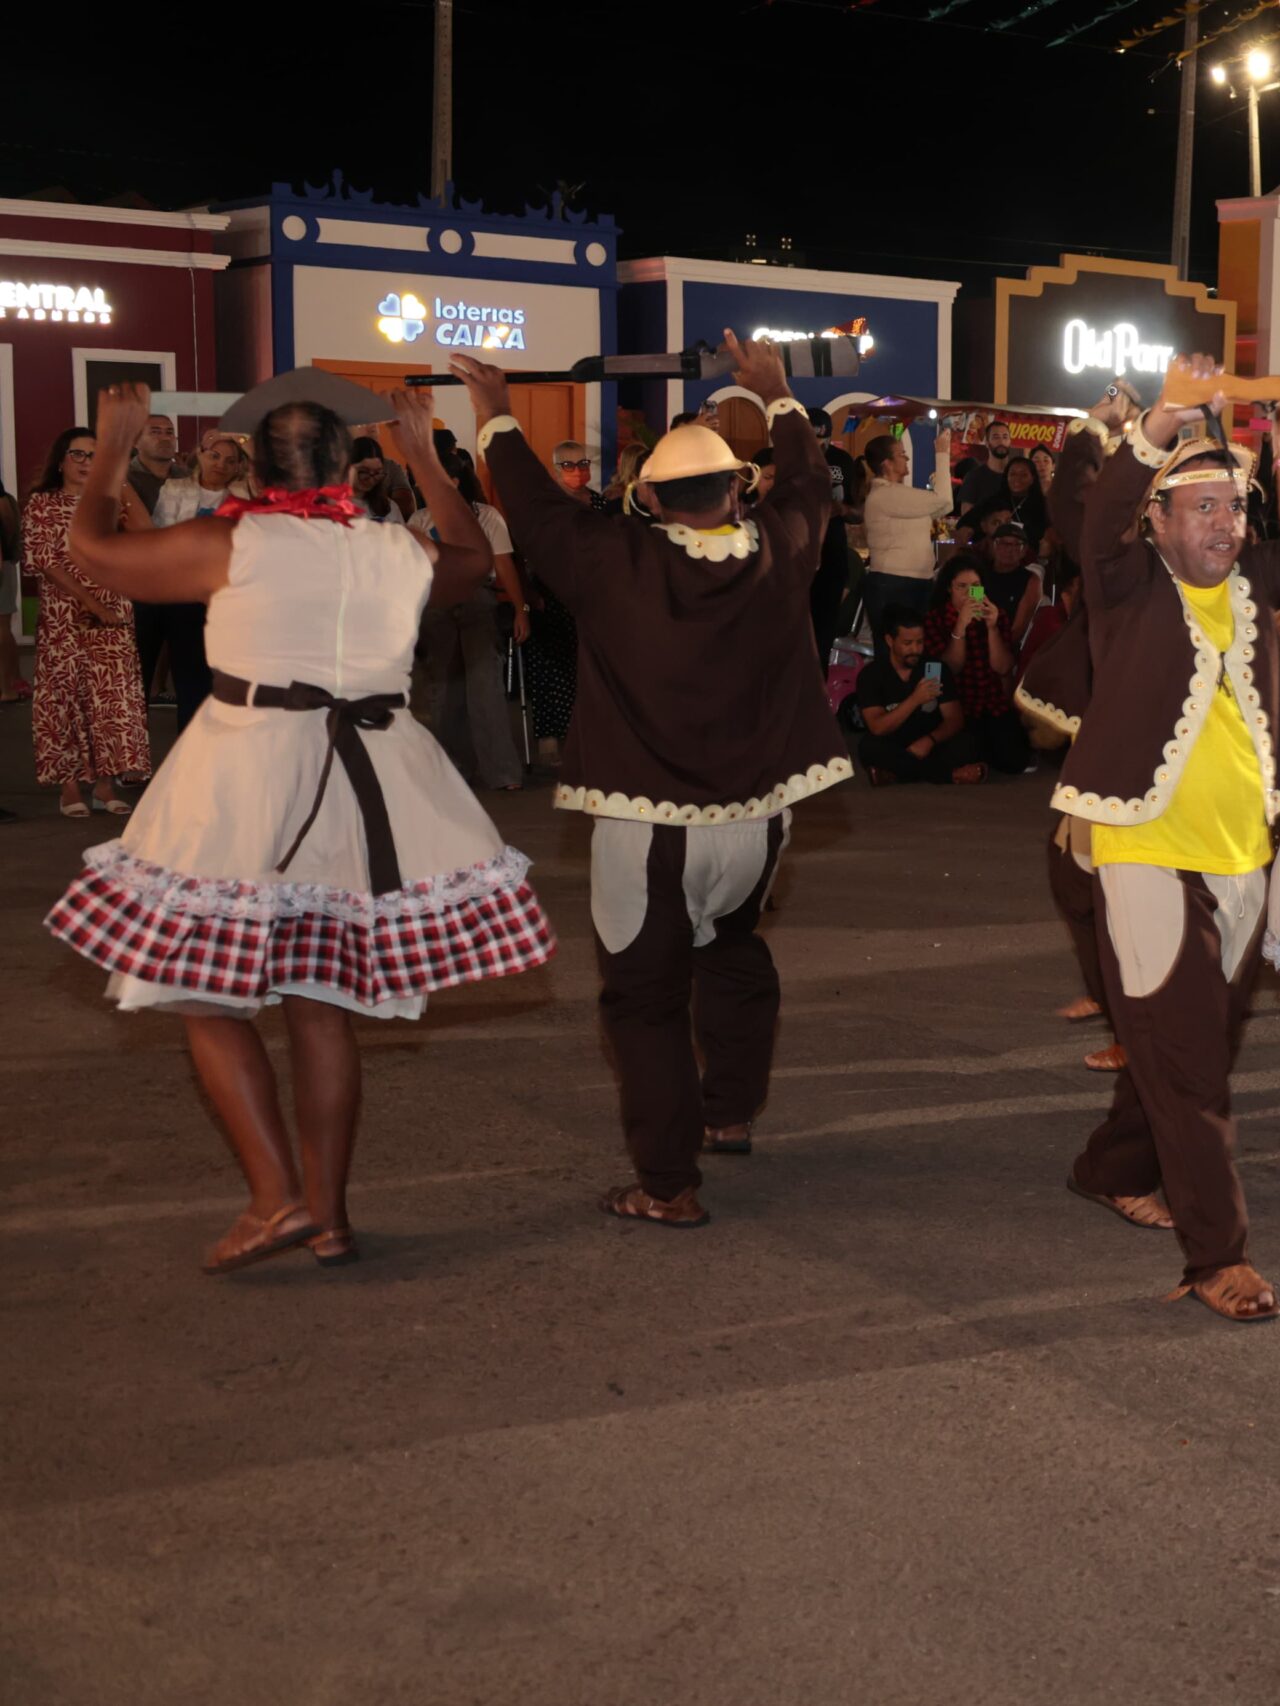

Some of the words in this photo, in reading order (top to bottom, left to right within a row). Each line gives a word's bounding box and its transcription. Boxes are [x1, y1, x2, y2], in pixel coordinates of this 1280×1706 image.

[435, 297, 525, 325] loterias
[435, 322, 526, 350] CAIXA
[1063, 318, 1113, 374] Old
[1009, 421, 1056, 443] URROS
